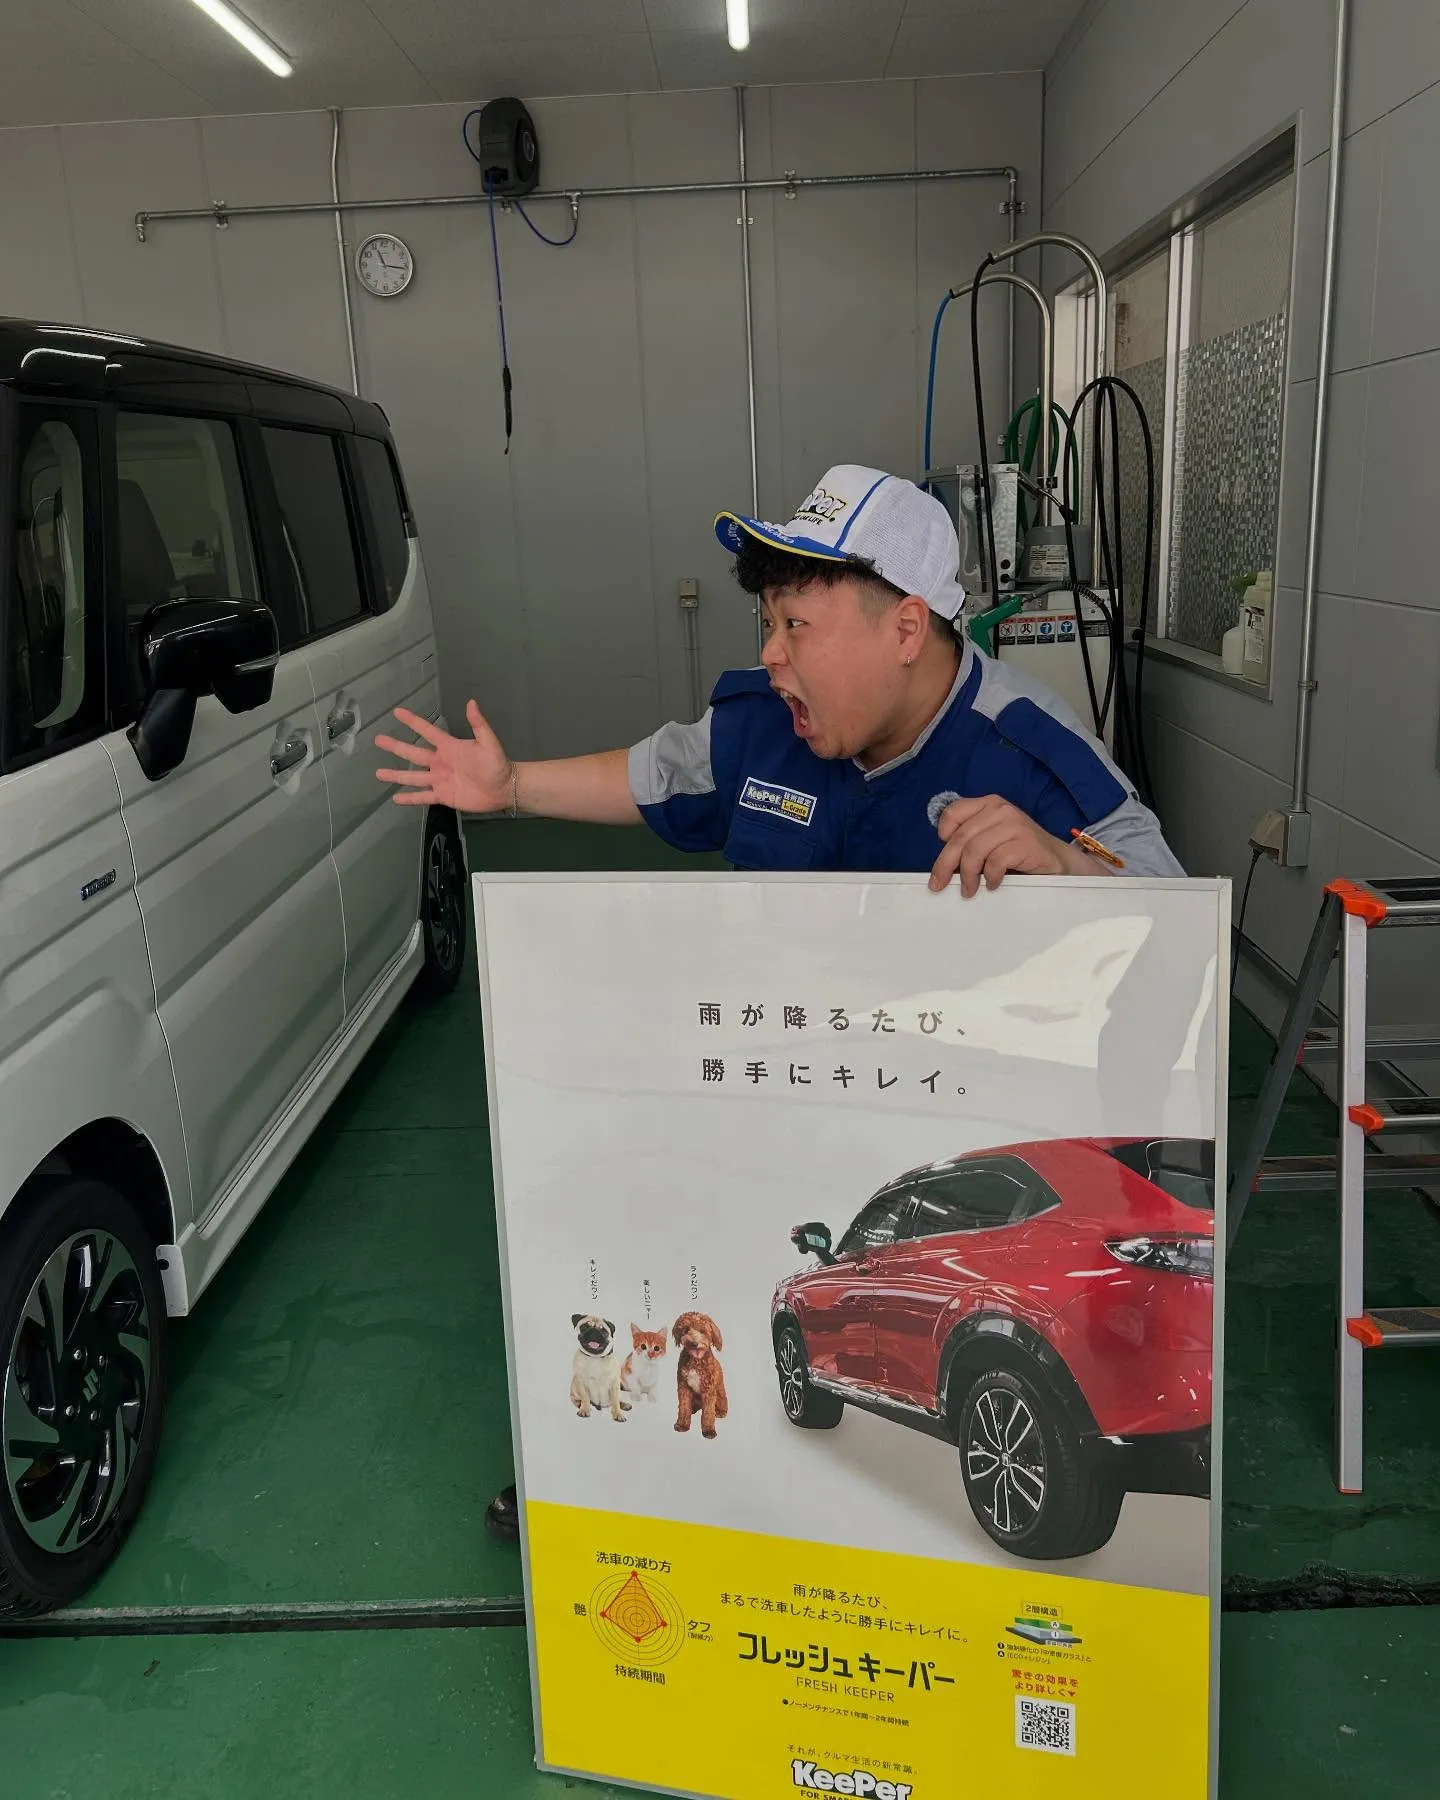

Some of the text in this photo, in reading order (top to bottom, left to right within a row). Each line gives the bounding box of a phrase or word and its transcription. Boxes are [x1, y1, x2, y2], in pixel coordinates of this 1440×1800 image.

[698, 1002, 965, 1036] 雨が降るたび、
[702, 1058, 966, 1095] 勝手にキレイ。
[596, 1551, 672, 1573] 洗車の減り方
[792, 1584, 888, 1610] 雨が降るたび、
[719, 1592, 968, 1643] まるで洗車したように勝手にキレイに。
[1025, 1604, 1058, 1616] 2層構造
[687, 1619, 711, 1632] タフ
[738, 1632, 956, 1691] フレッシュキーパー
[614, 1664, 666, 1685] 持続期間
[1011, 1668, 1078, 1688] 驚きの効果を
[796, 1676, 895, 1703] FRESH KEEPER
[1015, 1682, 1066, 1697] より詳しく
[791, 1758, 913, 1800] KeePer
[800, 1789, 820, 1800] FOR
